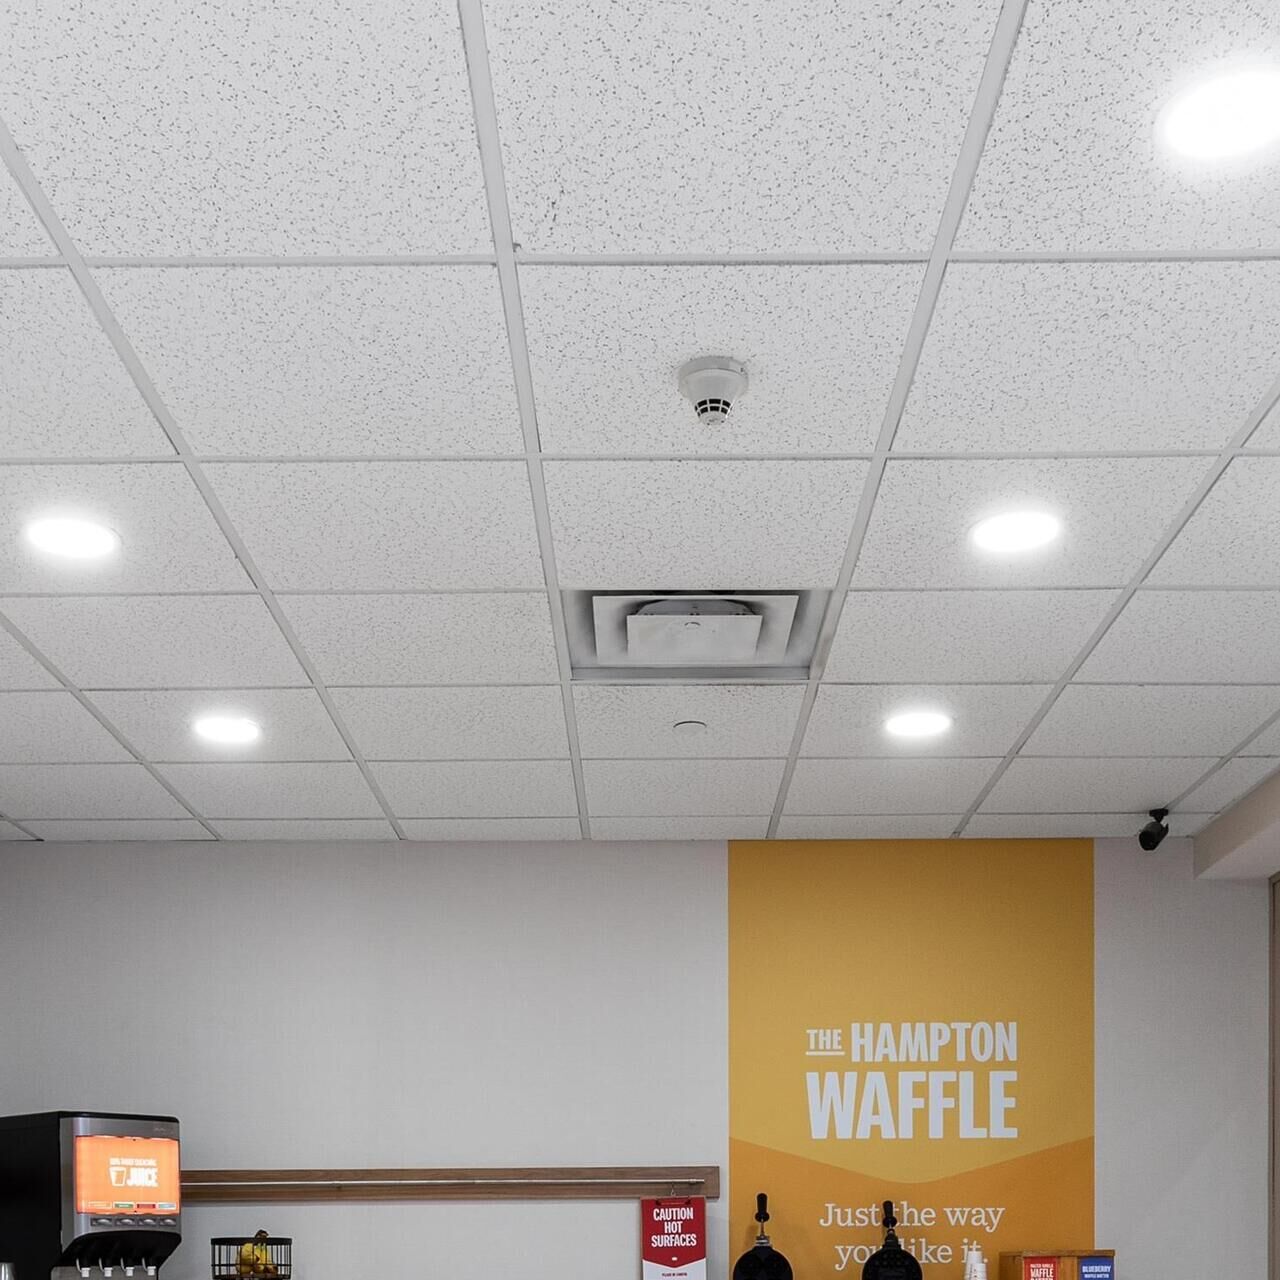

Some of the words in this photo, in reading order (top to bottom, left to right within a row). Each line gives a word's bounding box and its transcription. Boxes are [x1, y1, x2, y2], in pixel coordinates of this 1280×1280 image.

[806, 1029, 842, 1050] THE
[851, 1022, 1017, 1062] HAMPTON
[806, 1071, 1018, 1139] WAFFLE
[127, 1167, 159, 1187] JUICE
[653, 1207, 694, 1221] CAUTION
[820, 1203, 880, 1227] Just
[891, 1202, 936, 1226] the
[944, 1207, 1005, 1233] way
[664, 1221, 683, 1234] HOT
[651, 1234, 697, 1248] SURFACES
[835, 1245, 883, 1271] yo
[1030, 1269, 1054, 1277] WAFFLE
